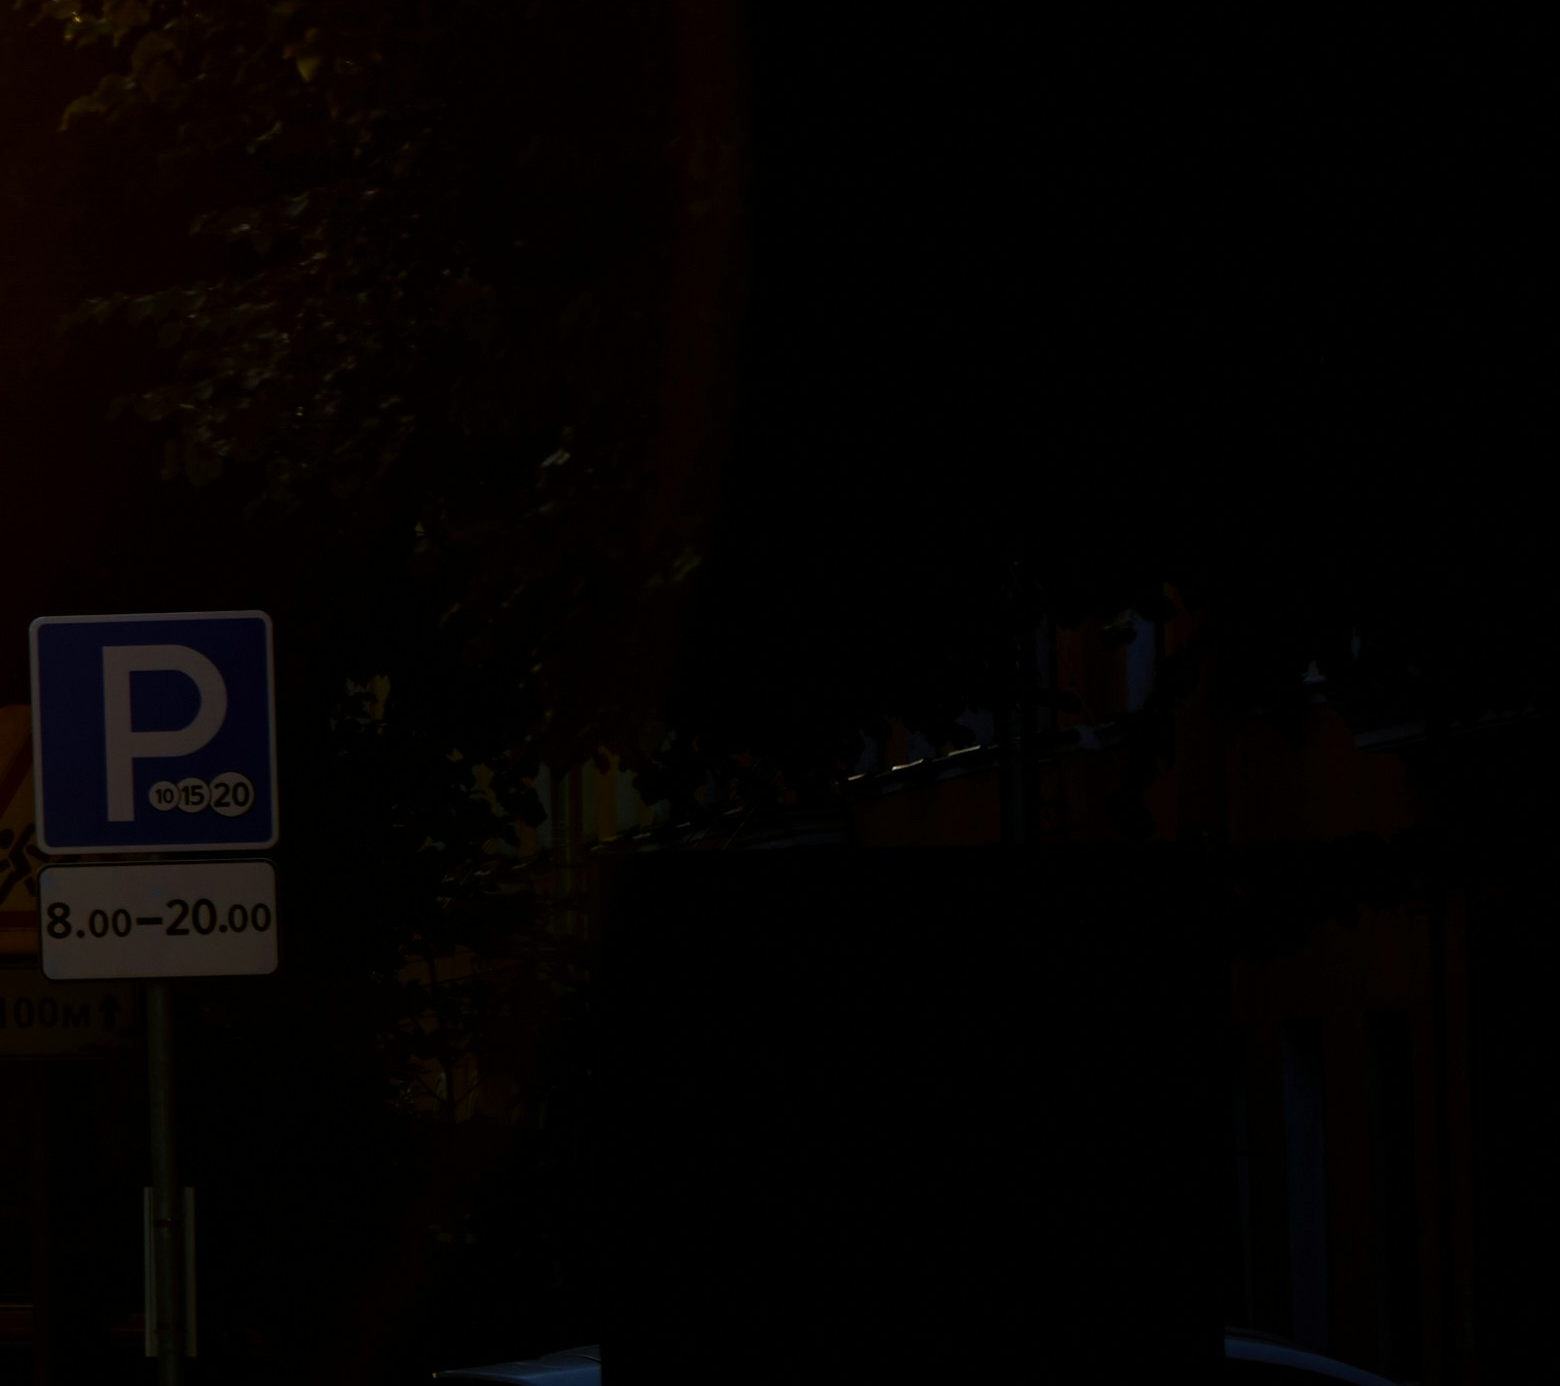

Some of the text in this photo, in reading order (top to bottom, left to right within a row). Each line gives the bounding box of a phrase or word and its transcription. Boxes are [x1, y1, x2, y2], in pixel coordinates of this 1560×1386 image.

[102, 644, 228, 821] P
[156, 781, 249, 808] 10 15 20
[47, 898, 271, 938] 8.00-20.00
